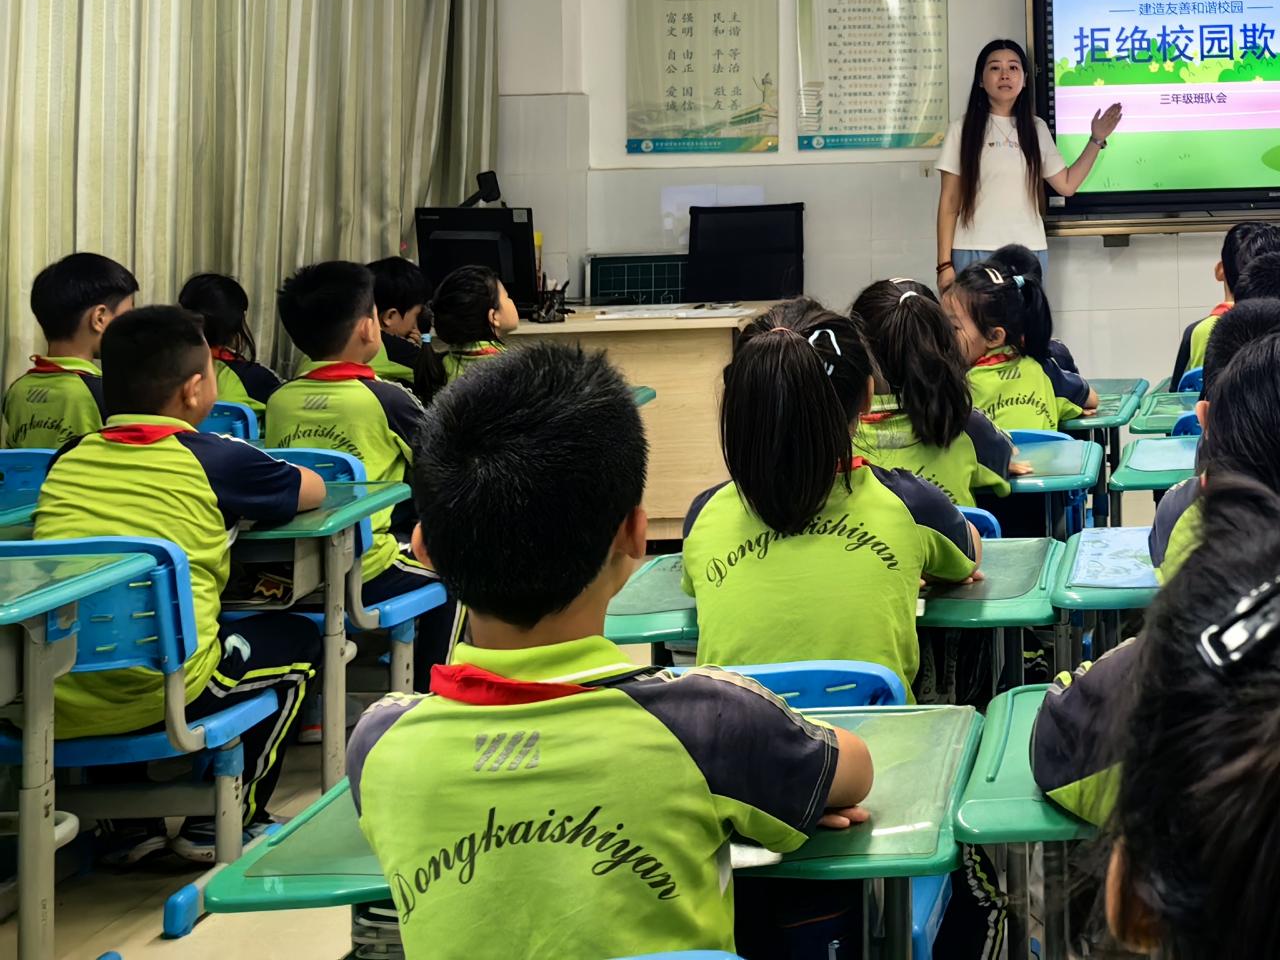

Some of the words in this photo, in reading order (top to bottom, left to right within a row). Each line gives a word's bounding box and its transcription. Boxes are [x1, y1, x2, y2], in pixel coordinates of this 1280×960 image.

[1139, 1, 1244, 16] 建造友善和谐校园
[665, 12, 694, 24] 富强
[666, 26, 694, 37] 文明
[713, 26, 742, 37] 和谐
[667, 48, 694, 61] 自由
[713, 48, 741, 61] 平等
[665, 63, 694, 74] 公正
[1160, 92, 1228, 105] 三年级班队会
[705, 513, 901, 588] Dongishiyan
[392, 805, 681, 925] Dongkaishiyan
